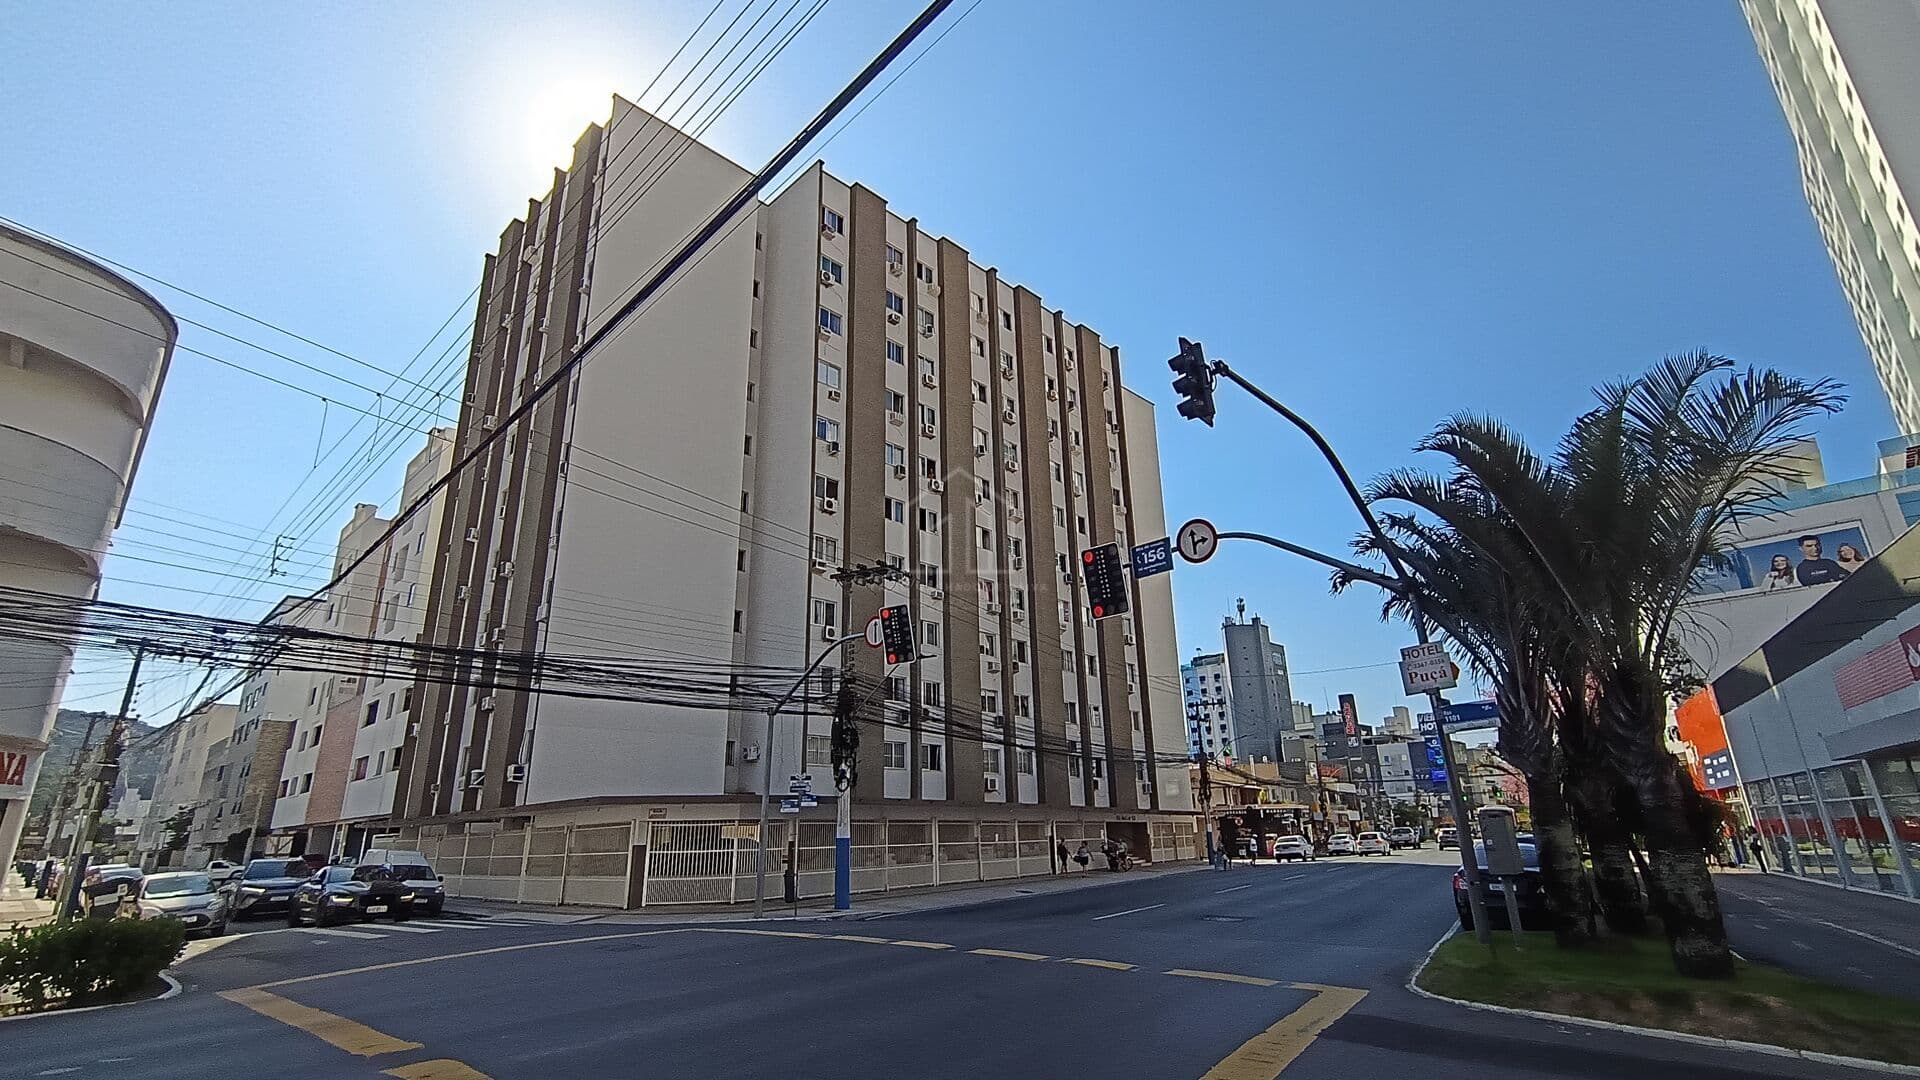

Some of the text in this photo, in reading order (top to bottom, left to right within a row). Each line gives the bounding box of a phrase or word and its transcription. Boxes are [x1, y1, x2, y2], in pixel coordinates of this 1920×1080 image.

[1141, 547, 1165, 564] 156
[1402, 645, 1442, 661] HOTEL
[1408, 665, 1448, 684] Puçá
[1444, 714, 1461, 723] 1101
